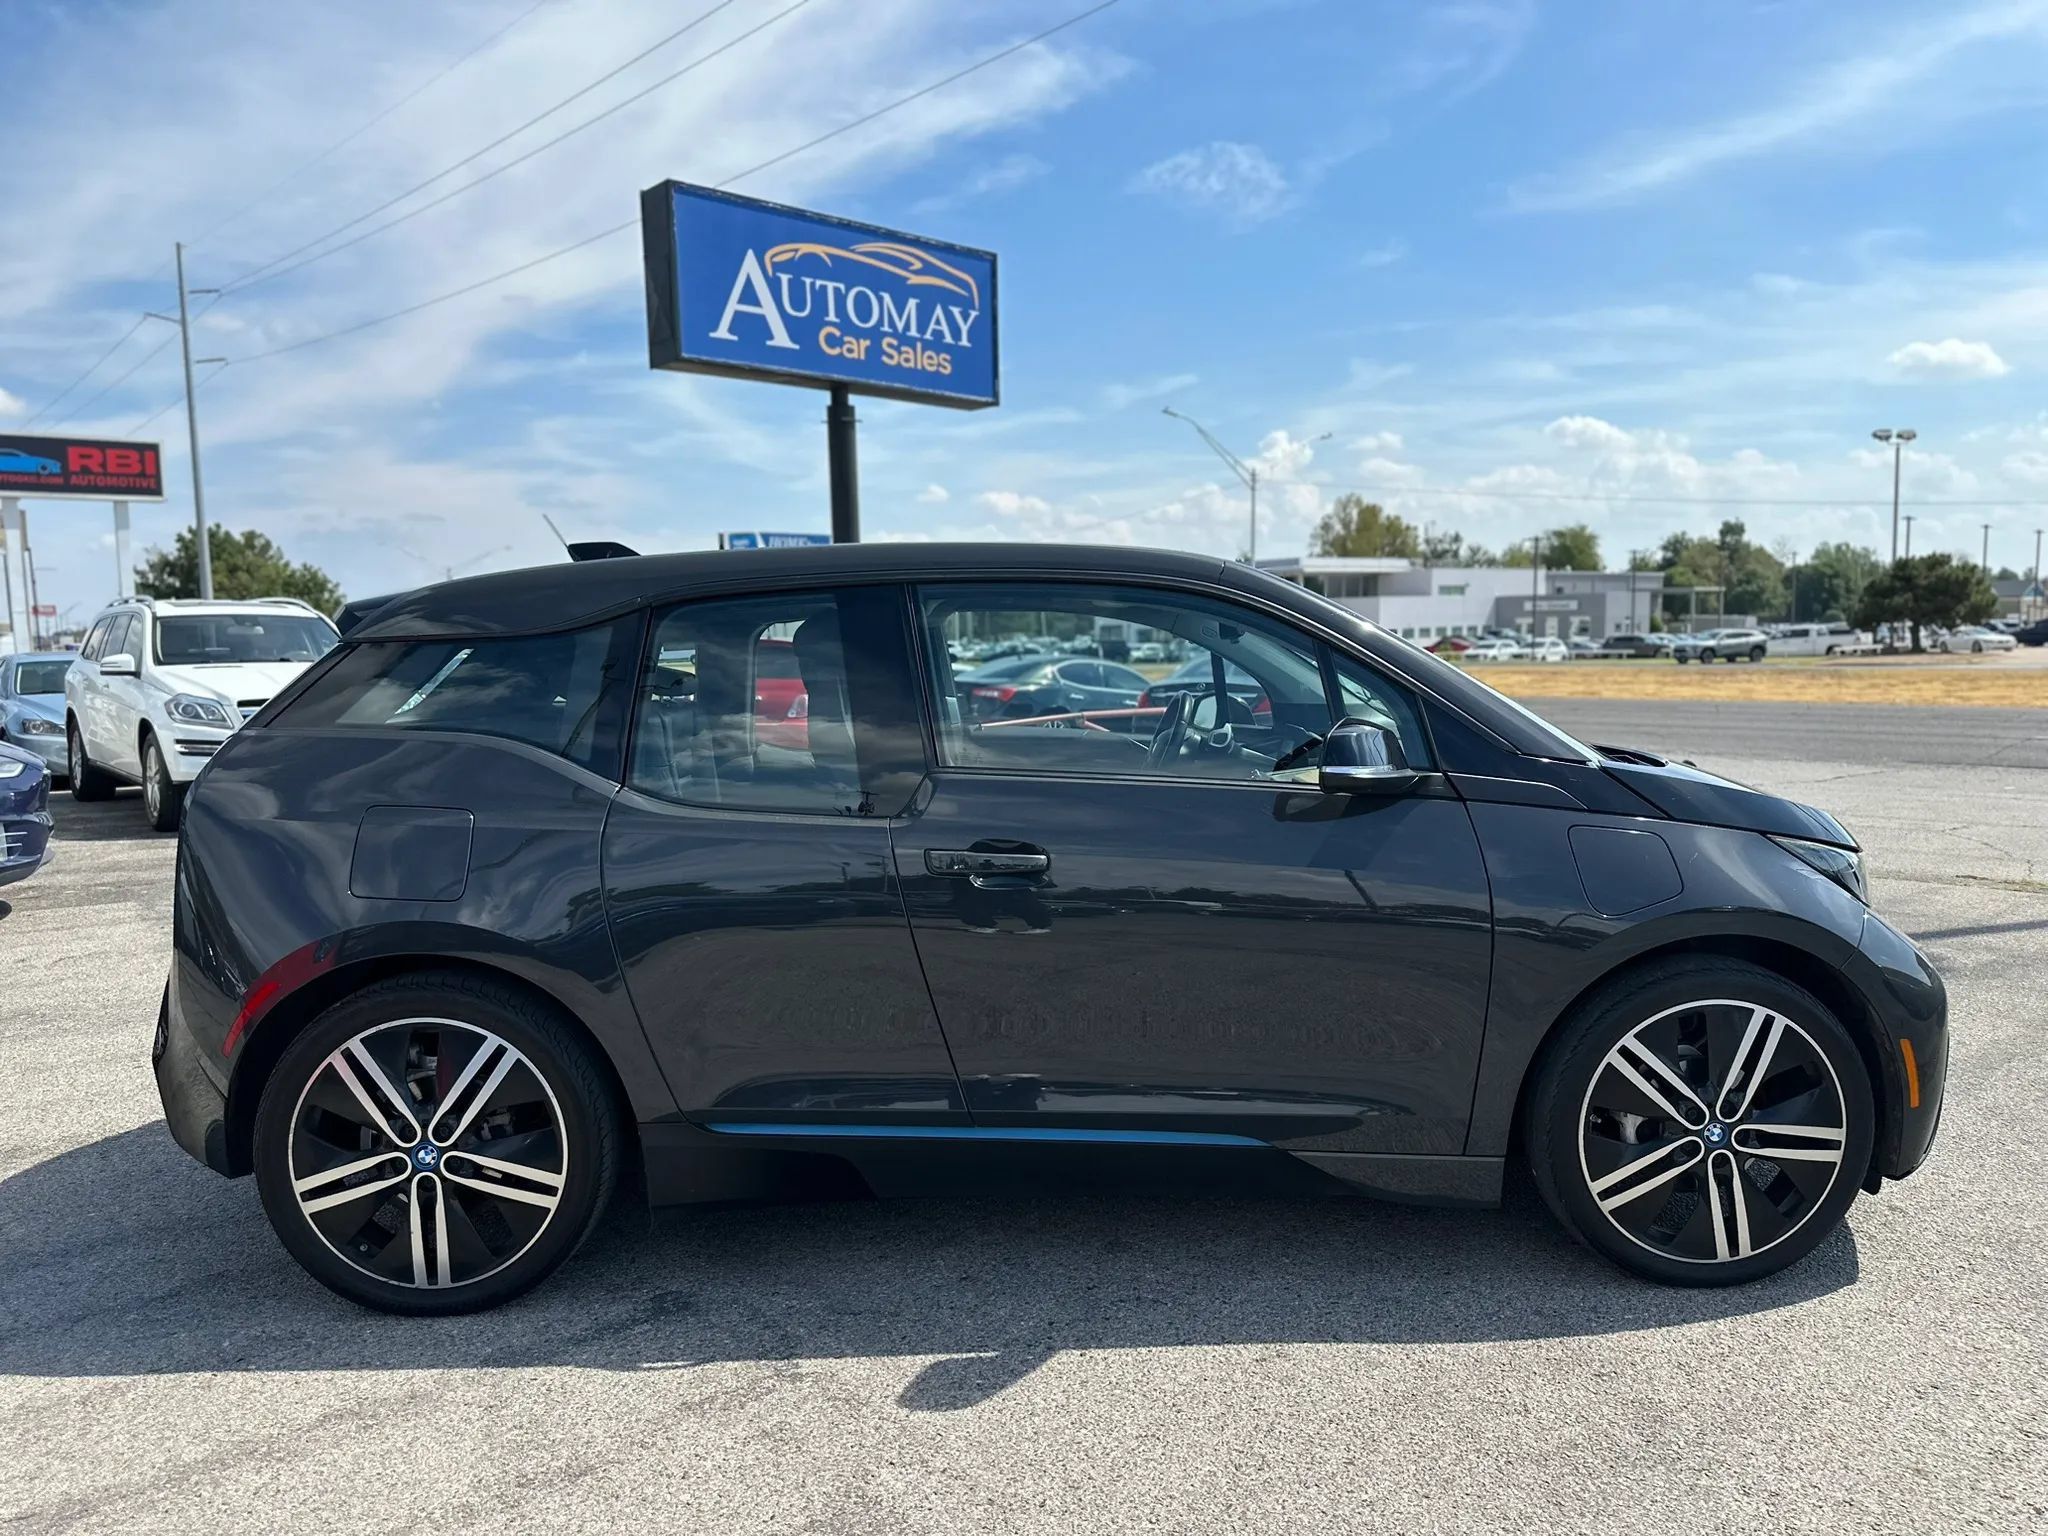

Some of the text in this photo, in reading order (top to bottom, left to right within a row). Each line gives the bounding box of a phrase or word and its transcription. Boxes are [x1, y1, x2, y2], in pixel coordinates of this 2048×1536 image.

[709, 249, 979, 349] AUTOMAY
[819, 326, 952, 375] Car Sales
[67, 446, 157, 476] RBI
[70, 474, 157, 489] AUTOMOTIVE
